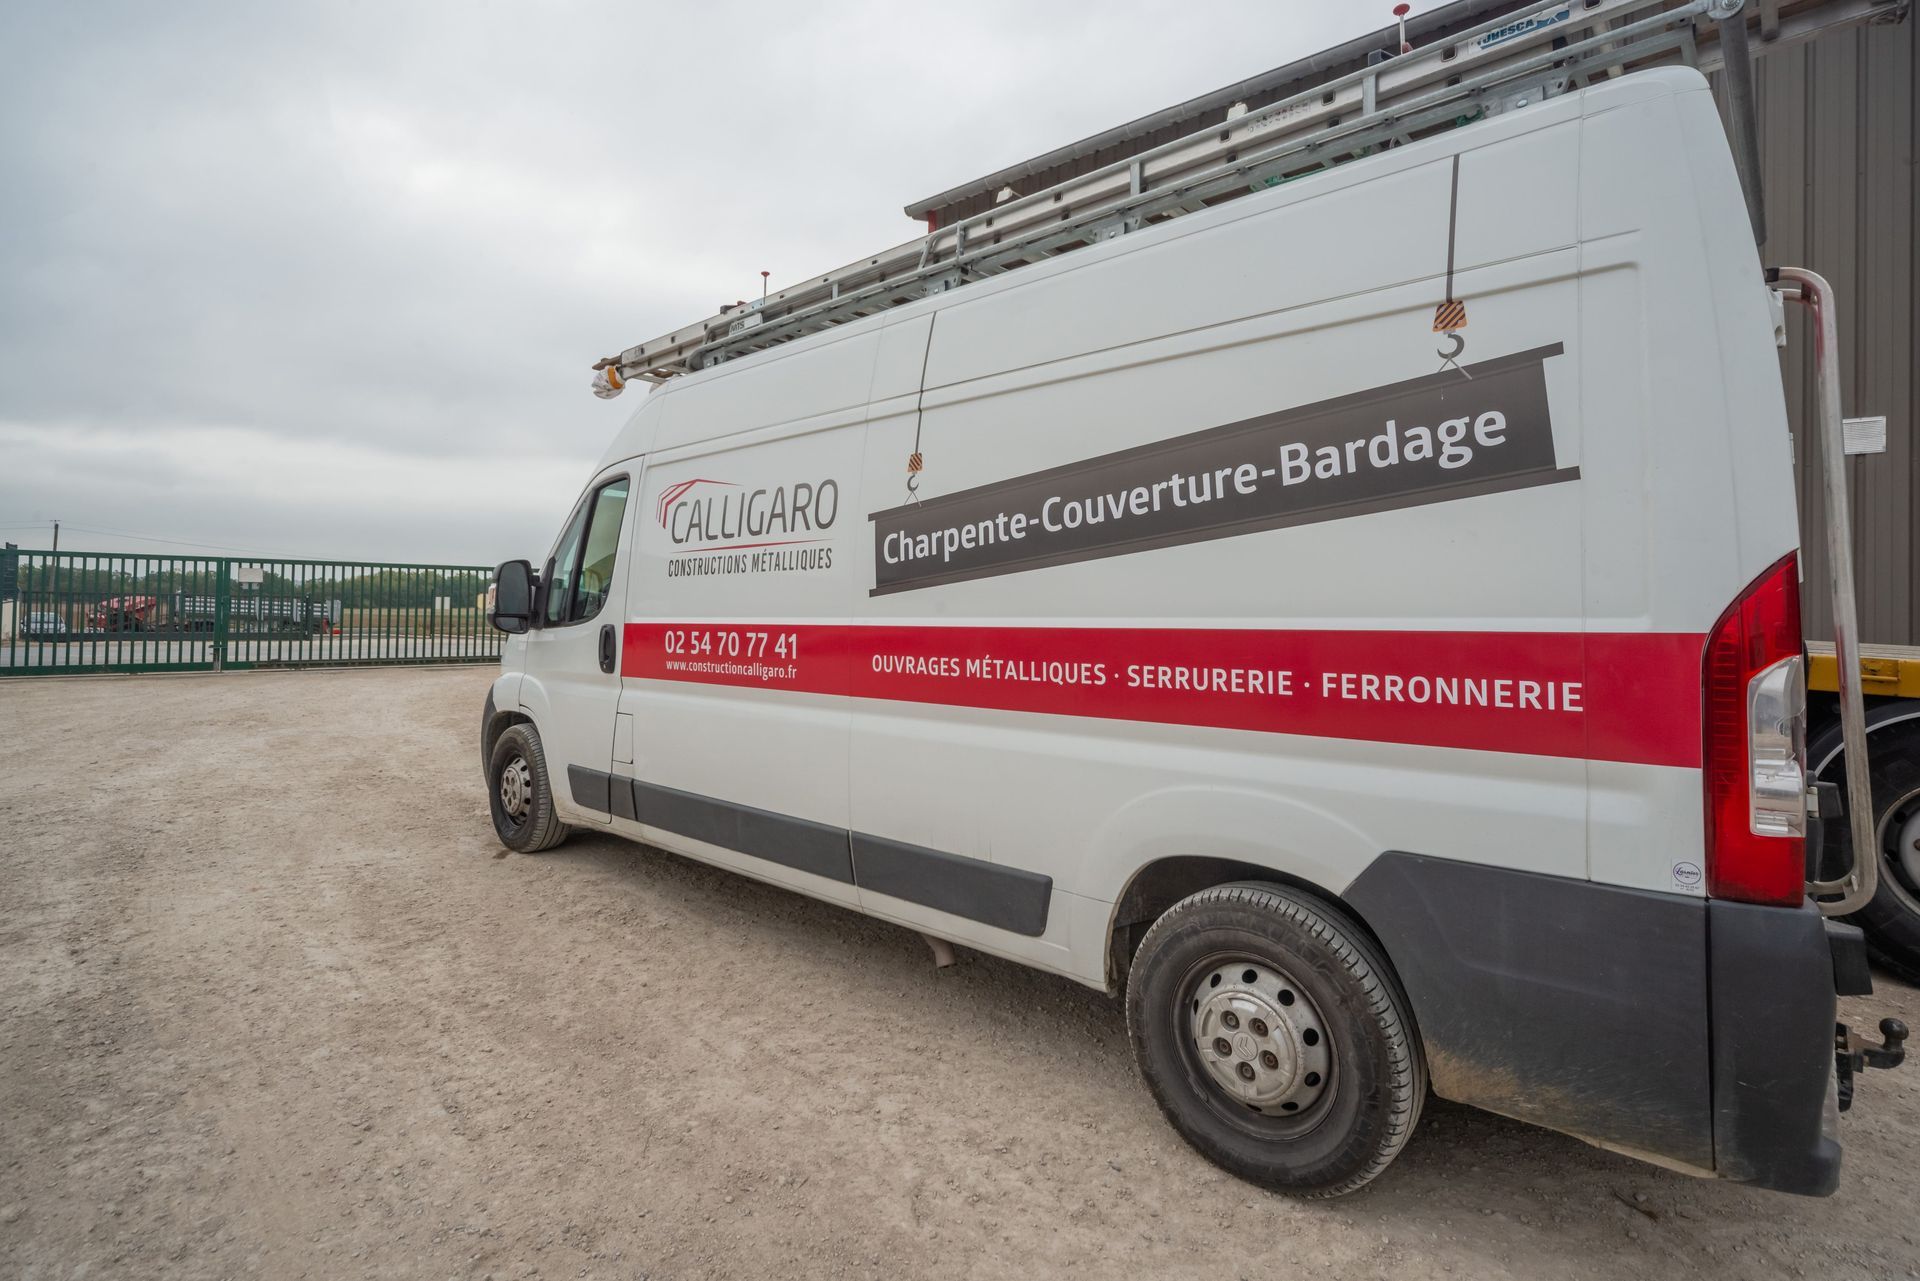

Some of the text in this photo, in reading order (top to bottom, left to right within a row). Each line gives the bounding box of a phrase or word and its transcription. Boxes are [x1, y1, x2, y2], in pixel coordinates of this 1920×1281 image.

[883, 410, 1507, 565] Charpente-Couverture-Bardage
[671, 479, 839, 544] CALLIGARO
[668, 547, 833, 578] CONSTRUCTIONS MÉTALLIQUES
[665, 630, 797, 660] 02 54 70 77 41
[666, 660, 797, 681] www.constructioncalligaro.fr
[872, 654, 1584, 712] OUVRAGES MÉTALLIQUES SERRURERIE FERRONNERIE
